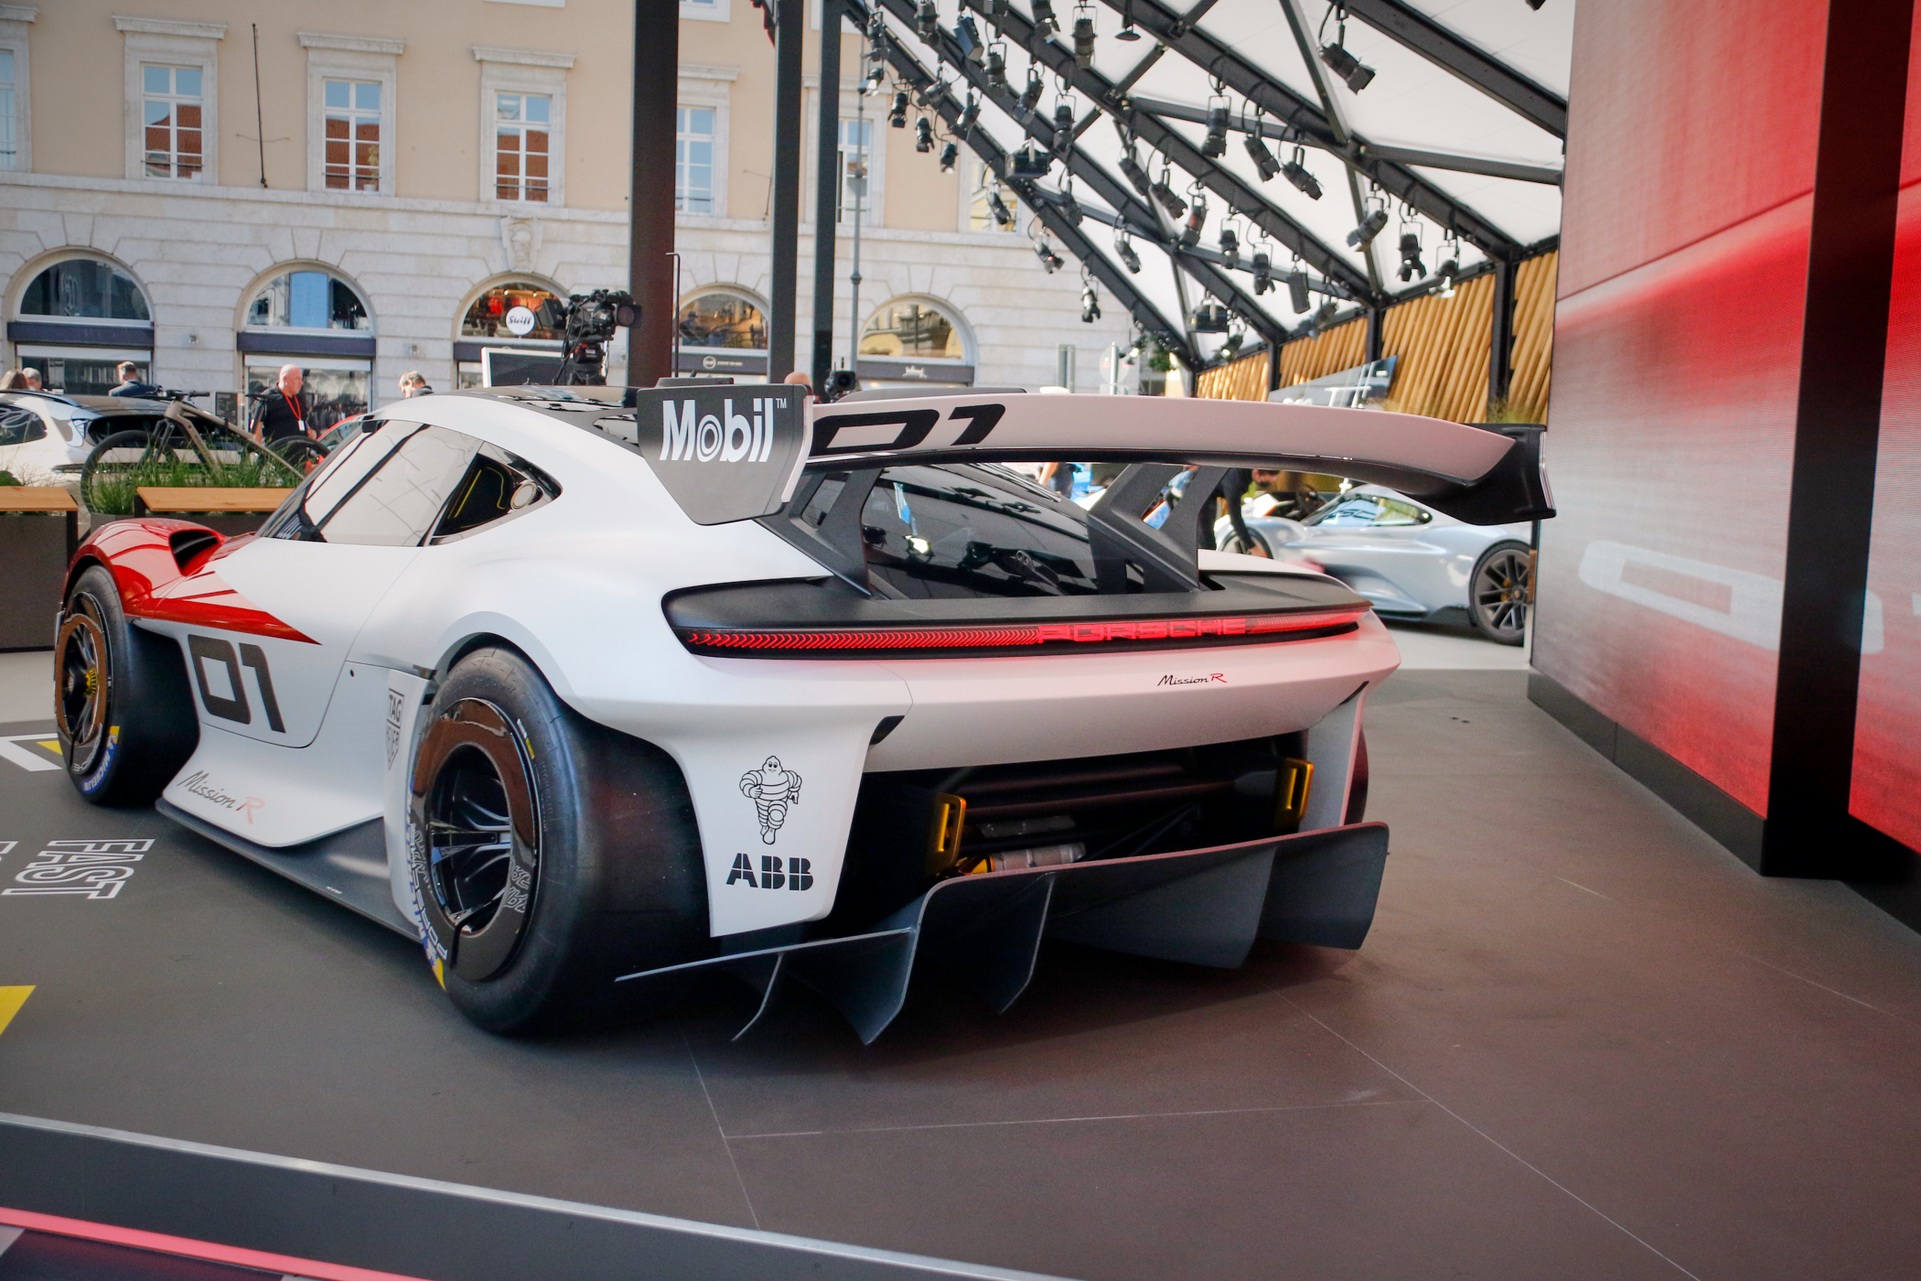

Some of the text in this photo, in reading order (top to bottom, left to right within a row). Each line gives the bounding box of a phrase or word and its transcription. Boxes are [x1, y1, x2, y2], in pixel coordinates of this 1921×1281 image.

[508, 315, 531, 325] Steiff
[659, 397, 774, 462] Mobil
[813, 403, 1006, 456] 01
[1037, 617, 1246, 644] PORSCHE
[187, 634, 287, 734] 01
[1157, 672, 1228, 687] Mission R
[387, 693, 403, 723] TAG
[177, 769, 266, 825] Mission R
[1, 838, 156, 900] FAST
[726, 852, 814, 892] ABB
